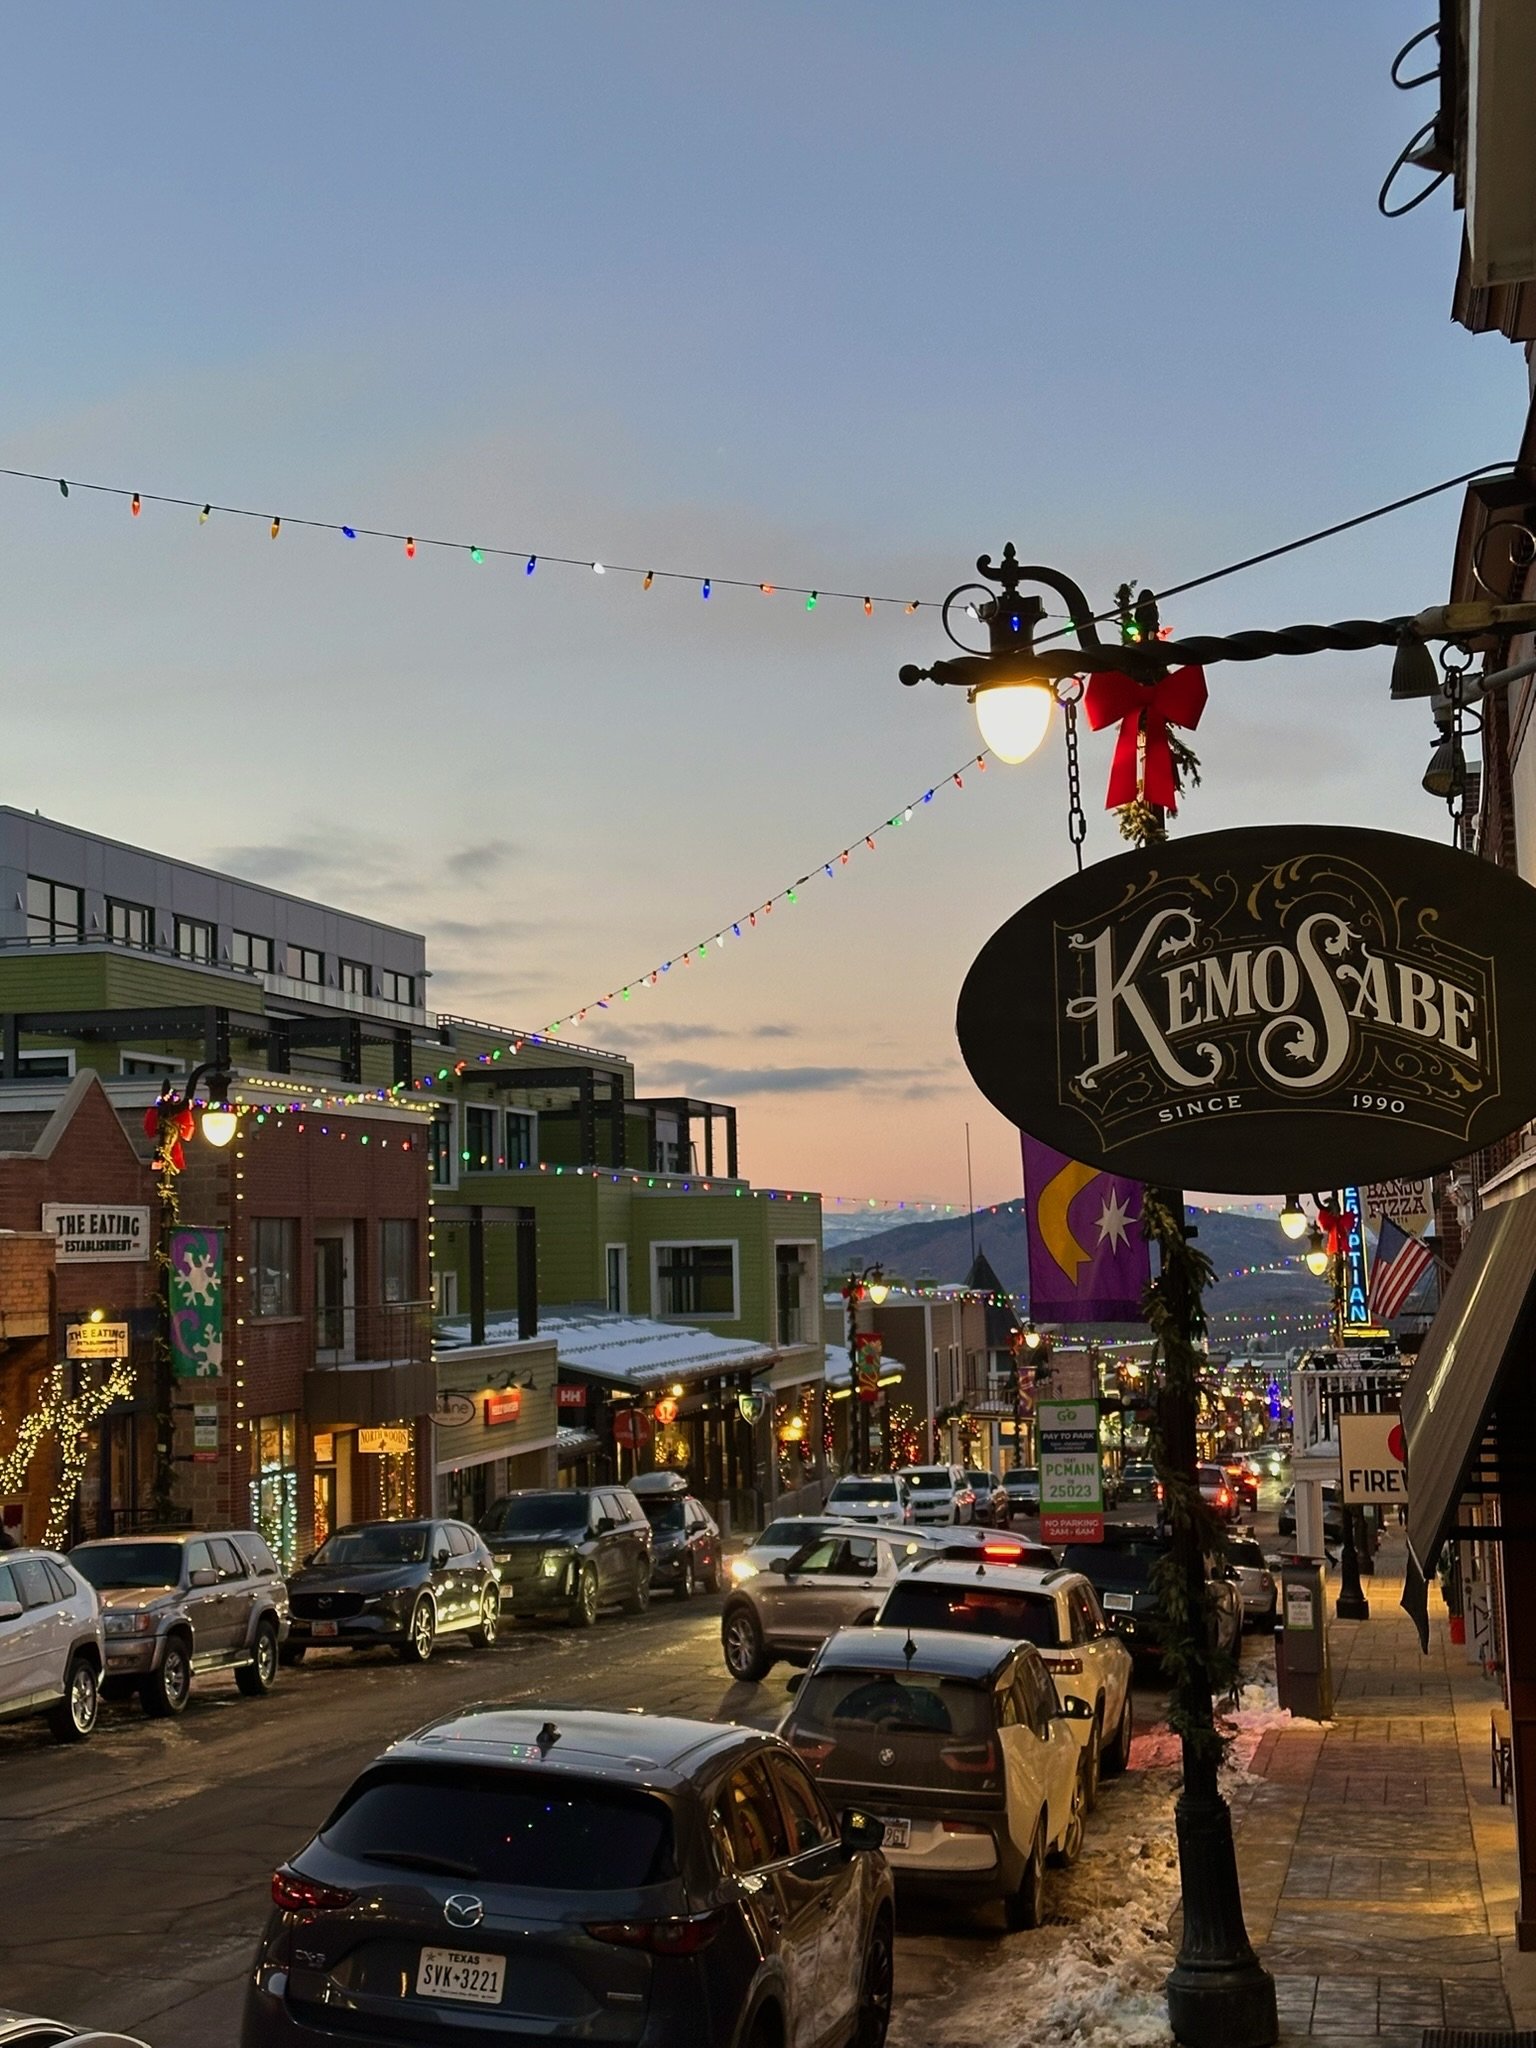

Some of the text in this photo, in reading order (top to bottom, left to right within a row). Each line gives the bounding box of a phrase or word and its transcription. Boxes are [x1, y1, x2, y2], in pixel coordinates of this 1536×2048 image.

[1158, 1095, 1405, 1123] SINCE 1990
[1368, 1196, 1427, 1219] PIZZA
[56, 1214, 140, 1237] THE EATING
[69, 1328, 126, 1341] THE EATING
[560, 1390, 581, 1403] HH
[1042, 1432, 1095, 1441] PAY TO PARK
[1045, 1463, 1095, 1476] PCMAIN
[1050, 1484, 1092, 1498] 25023
[1045, 1519, 1099, 1528] NO PARKING
[1050, 1528, 1070, 1536] 2AM
[448, 1952, 480, 1965] TEXAS
